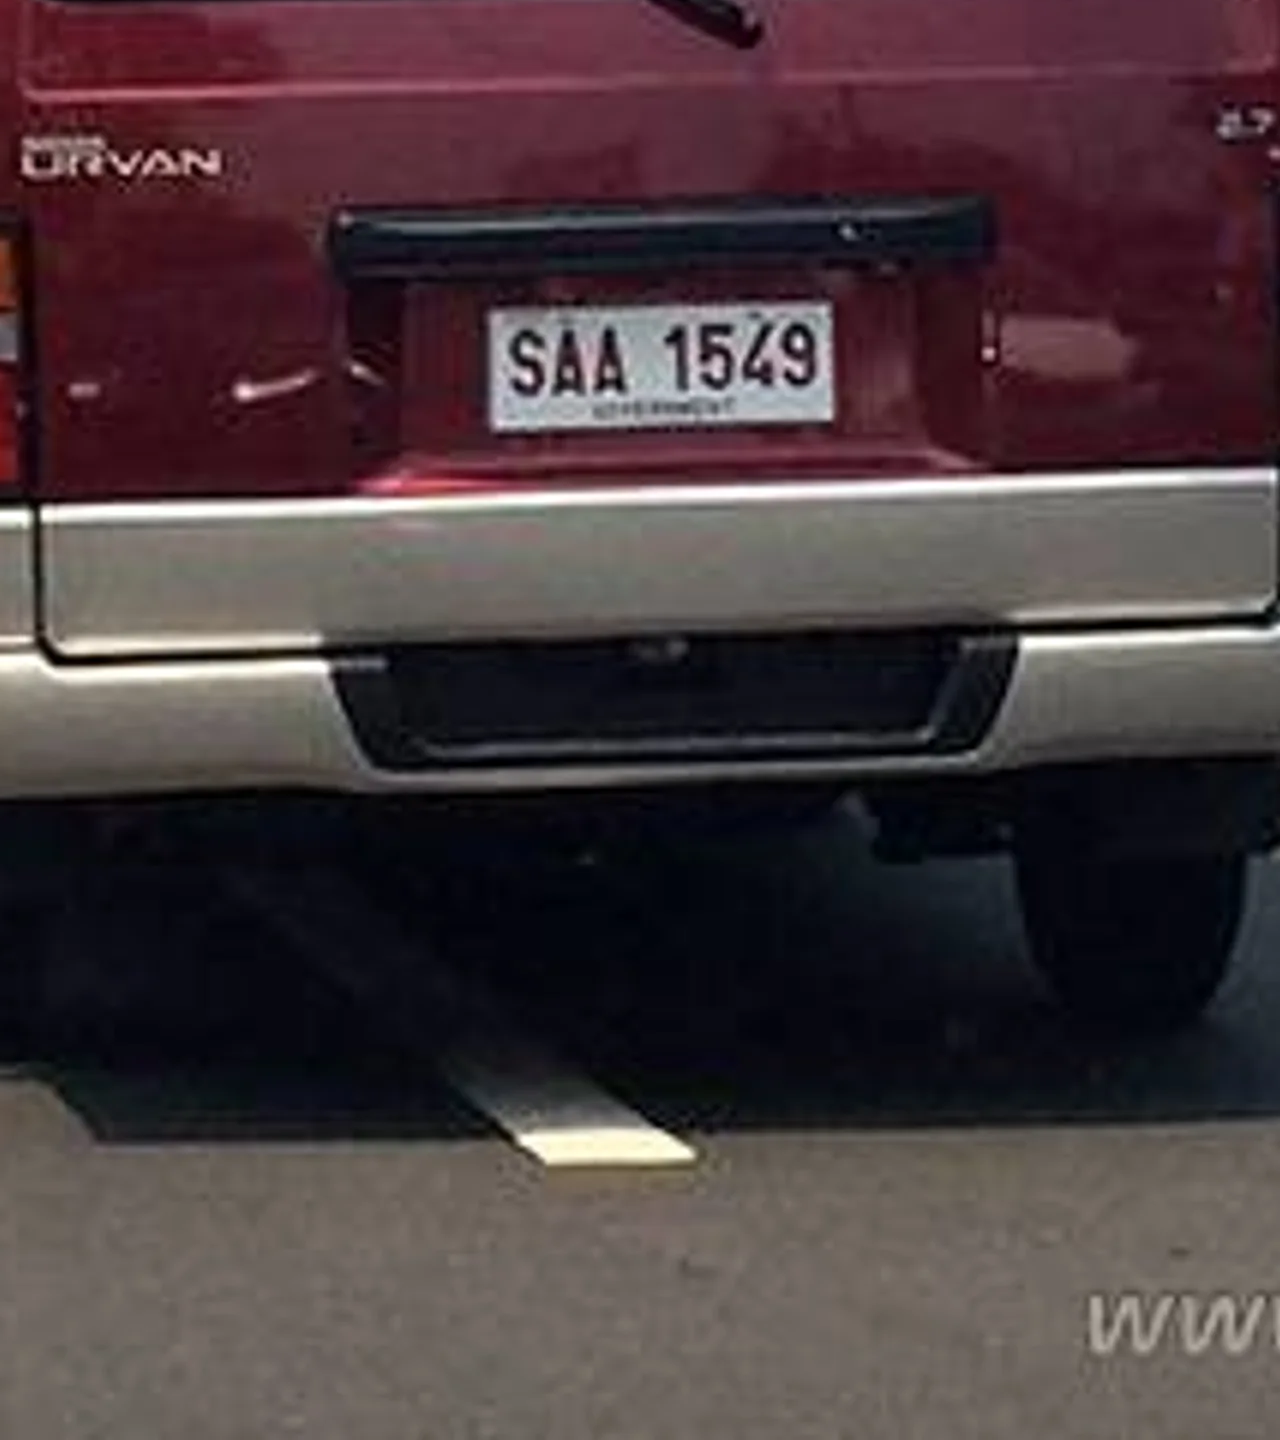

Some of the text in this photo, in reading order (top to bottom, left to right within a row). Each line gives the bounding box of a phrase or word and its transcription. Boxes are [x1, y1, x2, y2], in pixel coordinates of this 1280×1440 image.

[22, 144, 221, 181] URVAN
[508, 321, 817, 397] SAA 1549
